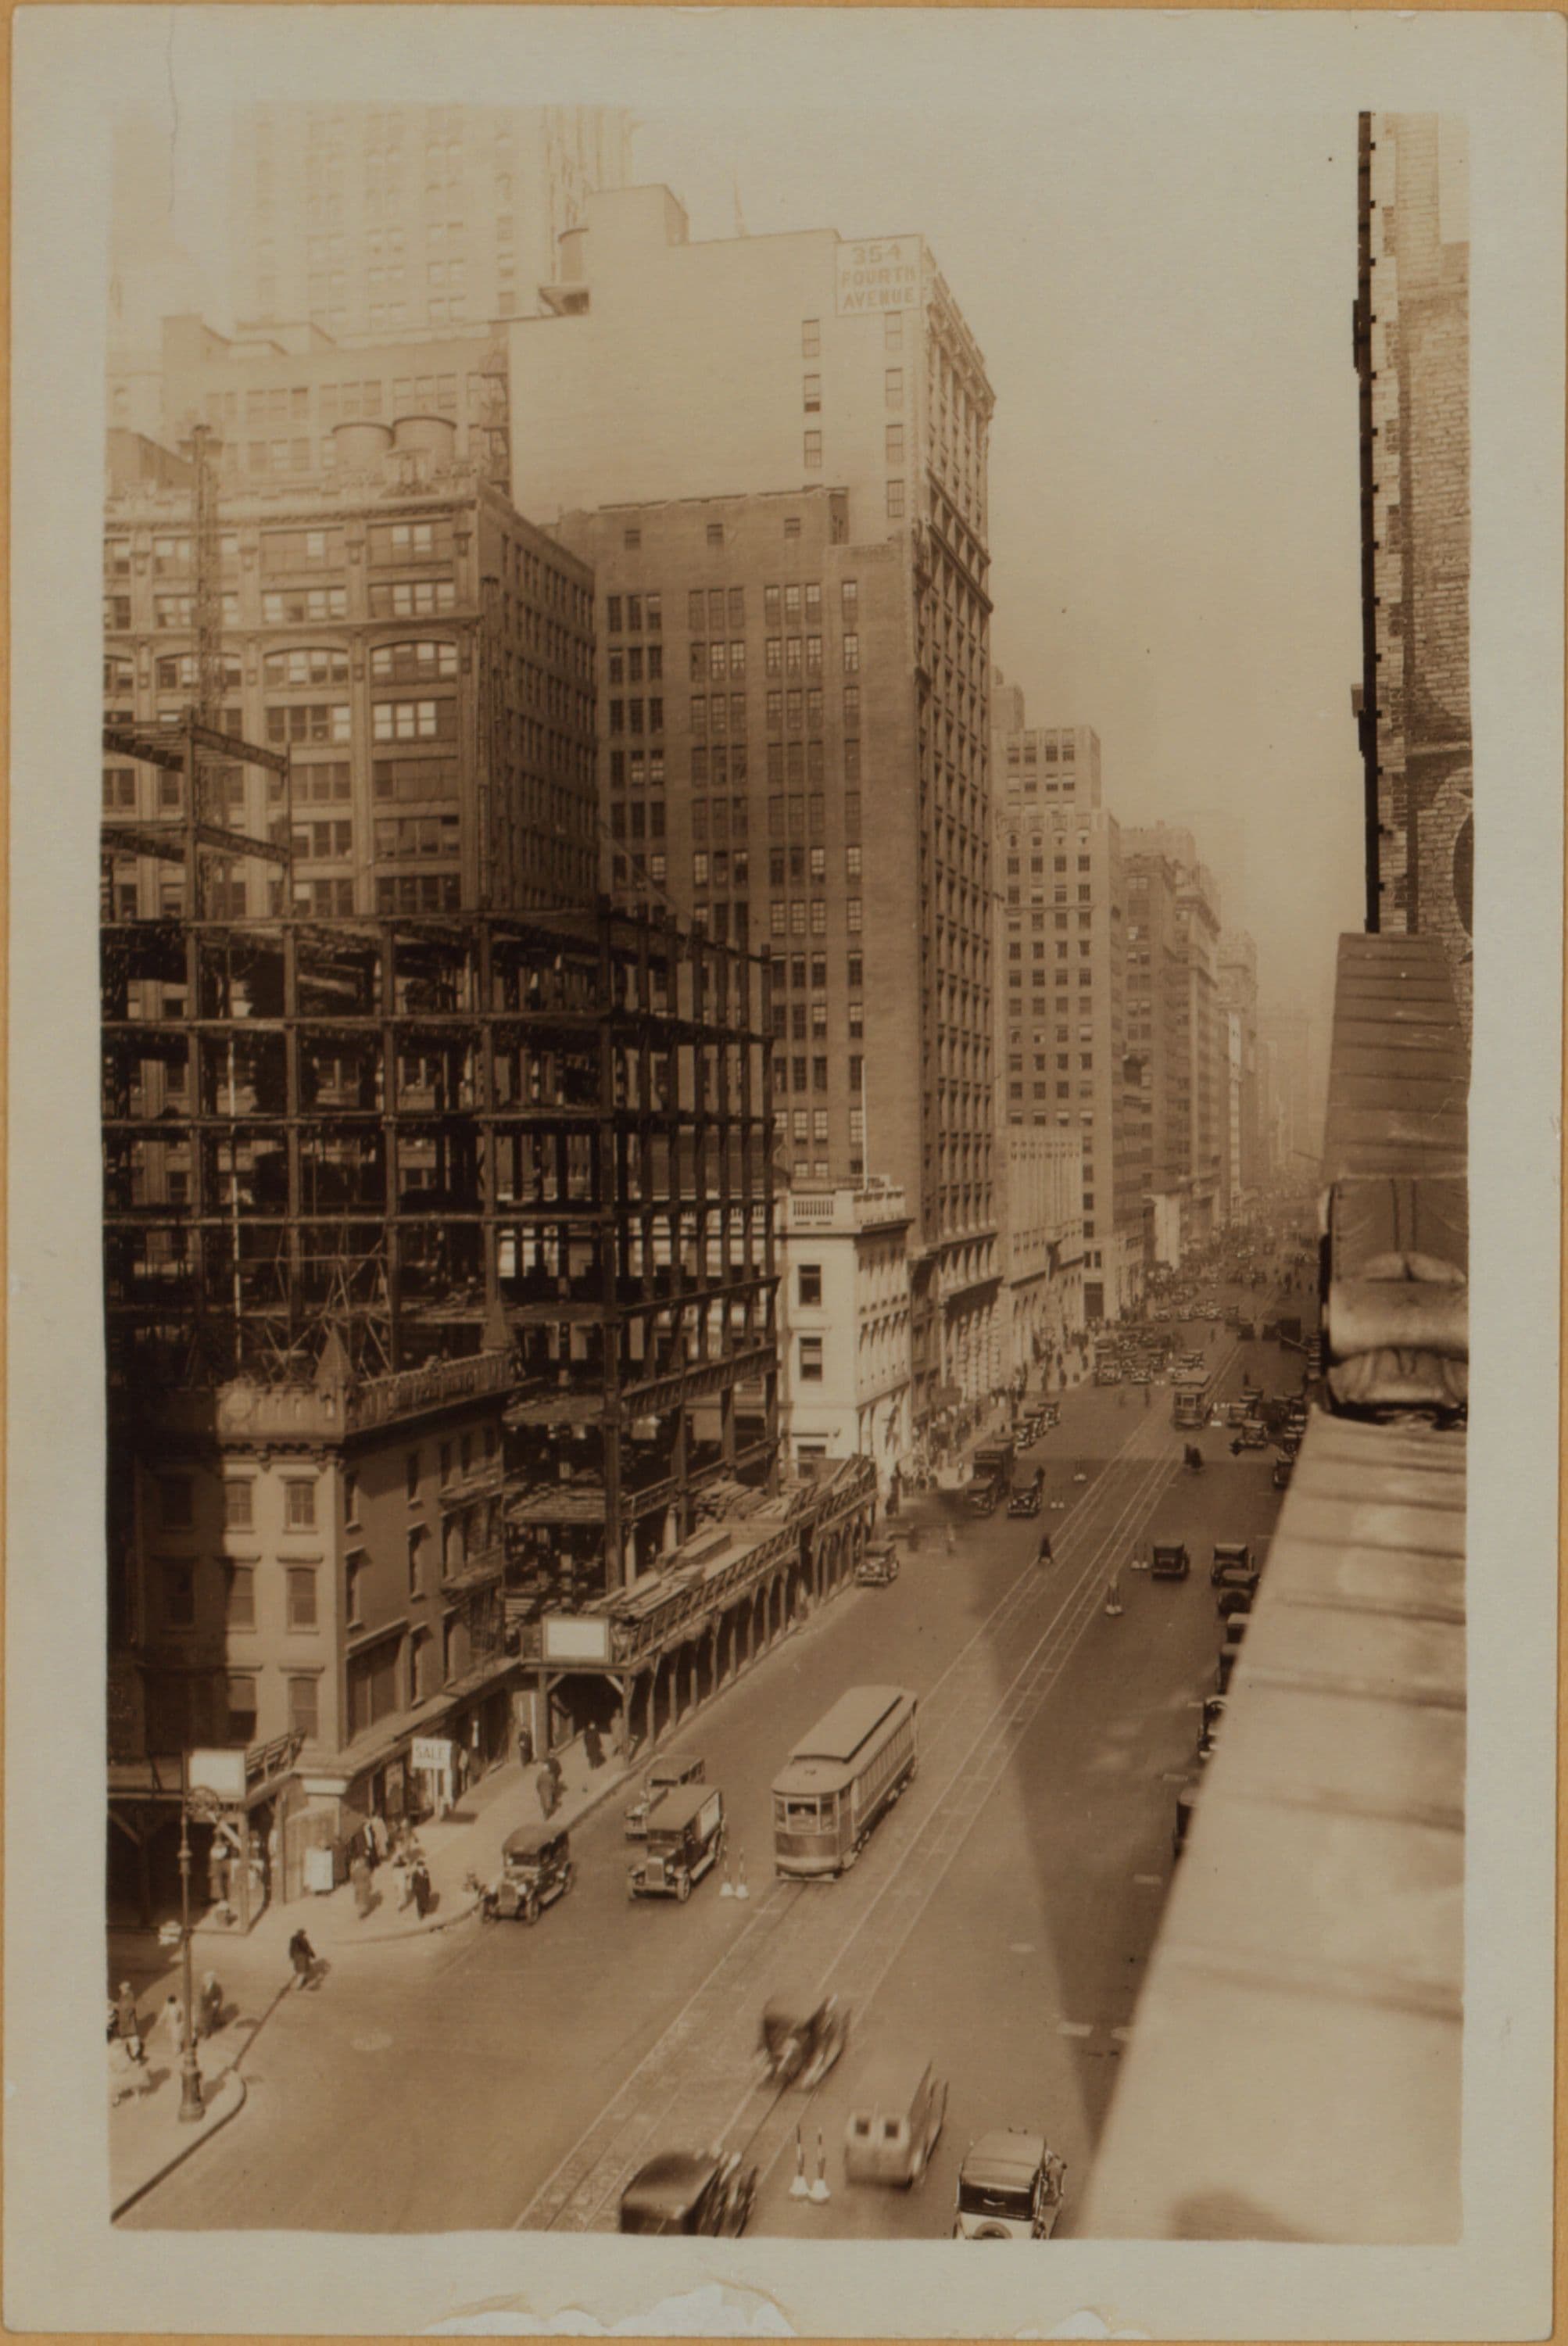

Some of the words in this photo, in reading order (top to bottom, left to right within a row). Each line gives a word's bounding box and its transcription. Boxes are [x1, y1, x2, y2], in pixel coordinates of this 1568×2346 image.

[852, 244, 900, 264] 354
[842, 266, 915, 288] FOURTH
[844, 288, 913, 309] AVENUE
